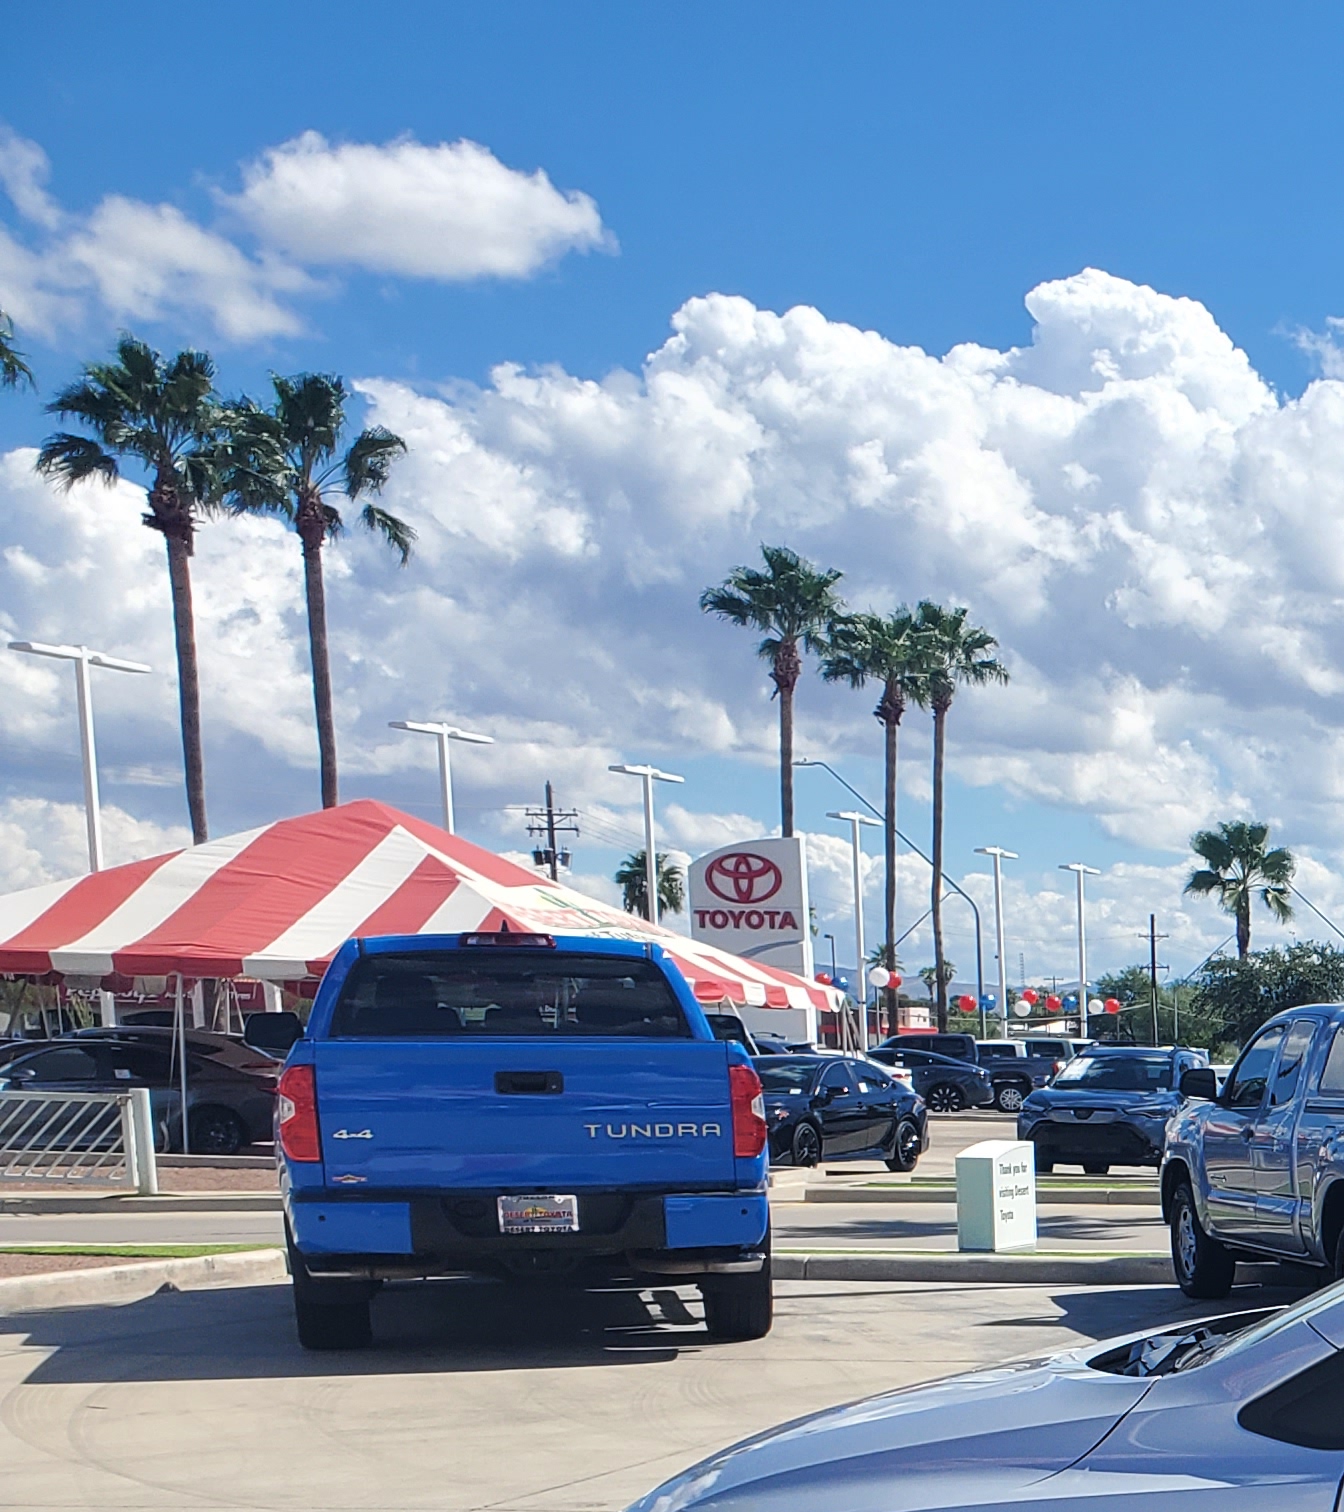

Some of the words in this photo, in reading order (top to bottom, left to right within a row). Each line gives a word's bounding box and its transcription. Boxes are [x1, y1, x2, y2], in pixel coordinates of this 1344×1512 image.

[693, 909, 799, 930] TOYOTA
[583, 1123, 721, 1138] TUNDRA
[999, 1163, 1012, 1175] Thank
[1012, 1165, 1021, 1176] you
[999, 1186, 1014, 1199] visiting
[1014, 1185, 1029, 1197] Desert
[1000, 1210, 1014, 1223] Toyota
